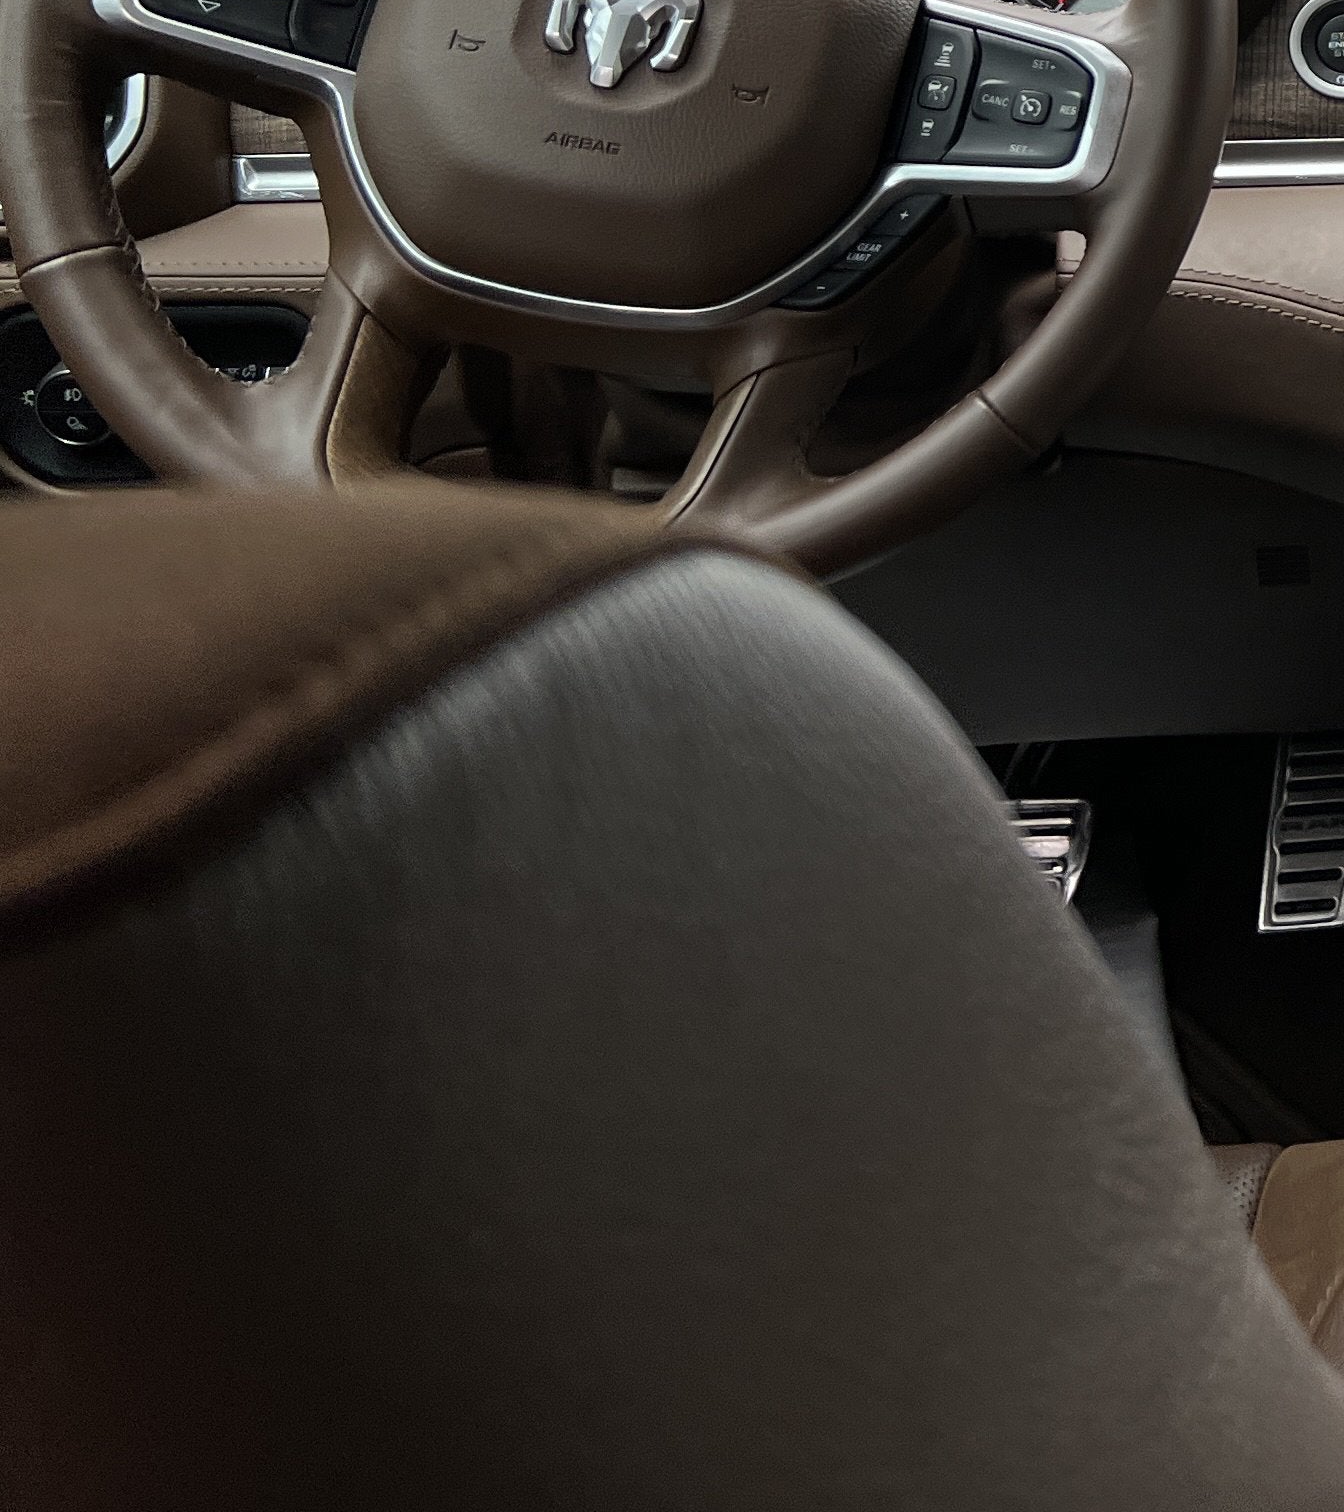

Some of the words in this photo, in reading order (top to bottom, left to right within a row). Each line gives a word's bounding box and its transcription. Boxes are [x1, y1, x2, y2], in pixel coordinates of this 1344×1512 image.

[981, 93, 1010, 108] CANC
[1059, 103, 1078, 116] RES
[543, 131, 622, 155] AIRBAG
[857, 242, 883, 253] GEAR
[846, 252, 873, 263] LIMIT
